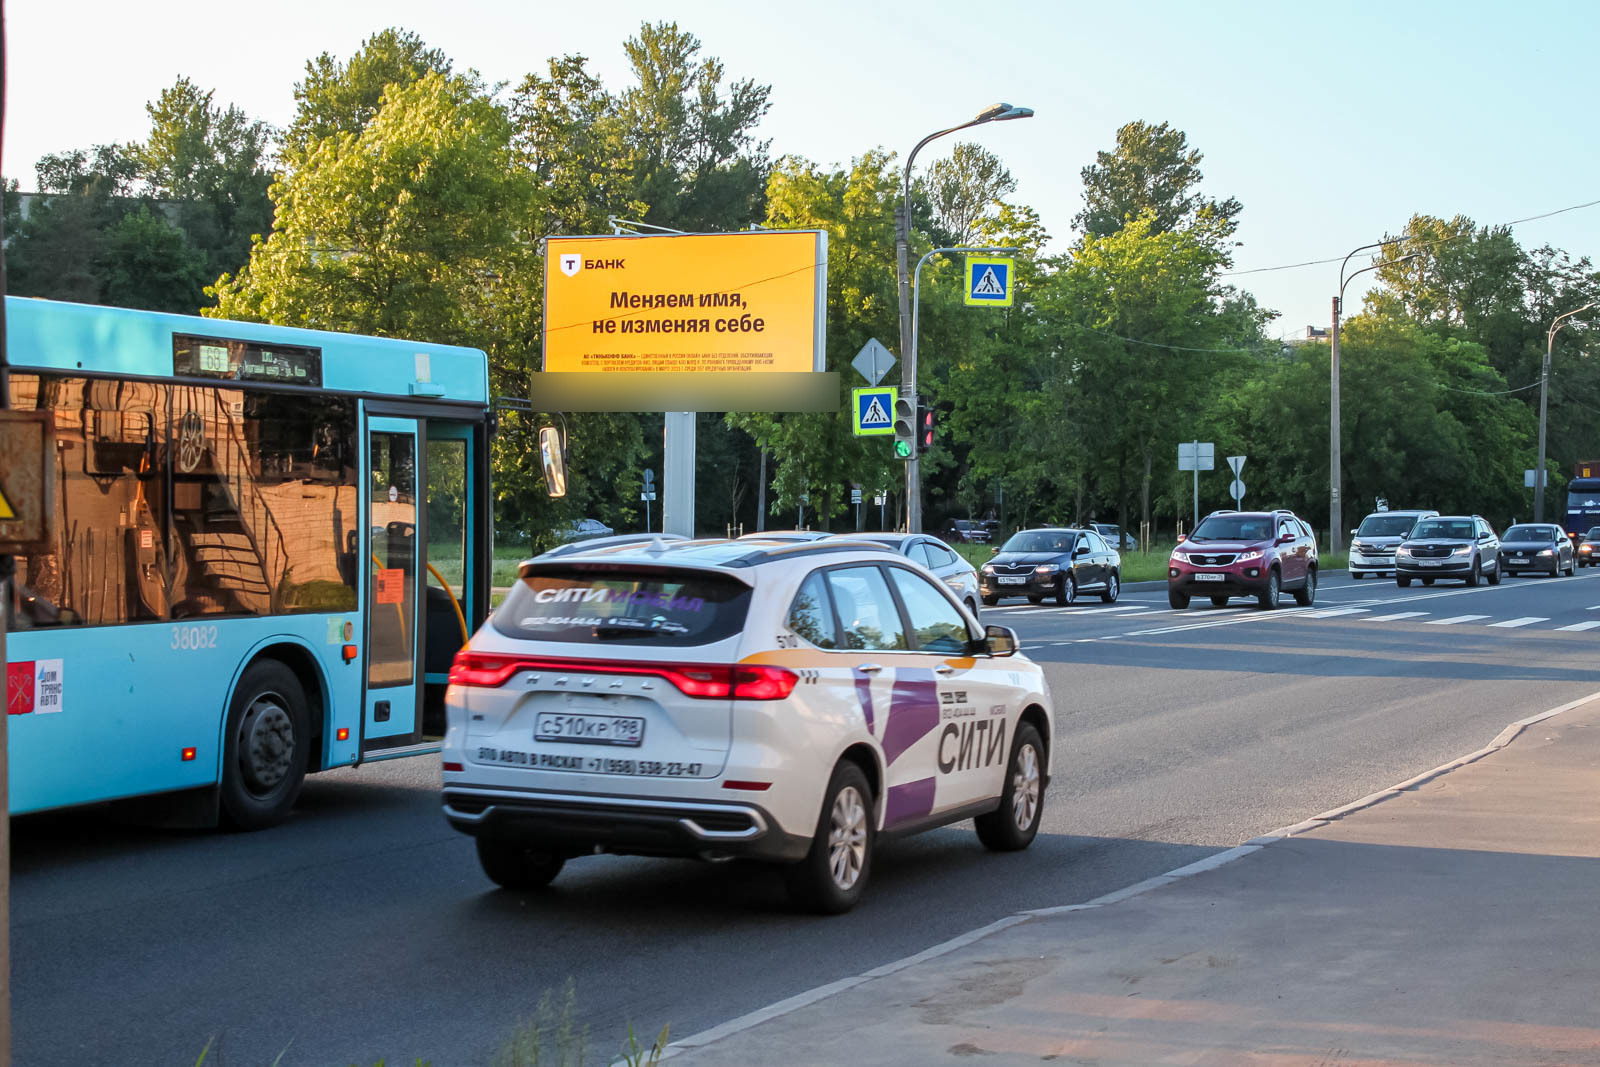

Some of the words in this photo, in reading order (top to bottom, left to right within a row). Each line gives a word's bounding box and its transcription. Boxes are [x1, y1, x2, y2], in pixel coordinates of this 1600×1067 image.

[584, 258, 626, 270] БАНК
[609, 291, 695, 309] Меняем
[699, 291, 748, 311] имя,
[592, 319, 617, 334] не
[621, 318, 711, 334] изменяя
[714, 313, 766, 333] себе
[170, 625, 218, 650] 38082
[41, 683, 62, 695] ТРАНС
[526, 673, 655, 691] HAVAL
[40, 695, 58, 706] АВТО
[612, 719, 640, 735] 198
[937, 717, 1007, 775] СИТИ
[478, 747, 497, 760] ЭТО
[500, 750, 527, 765] АВТО
[530, 753, 538, 766] В
[541, 753, 584, 770] РАСКАТ
[587, 758, 602, 771] +7
